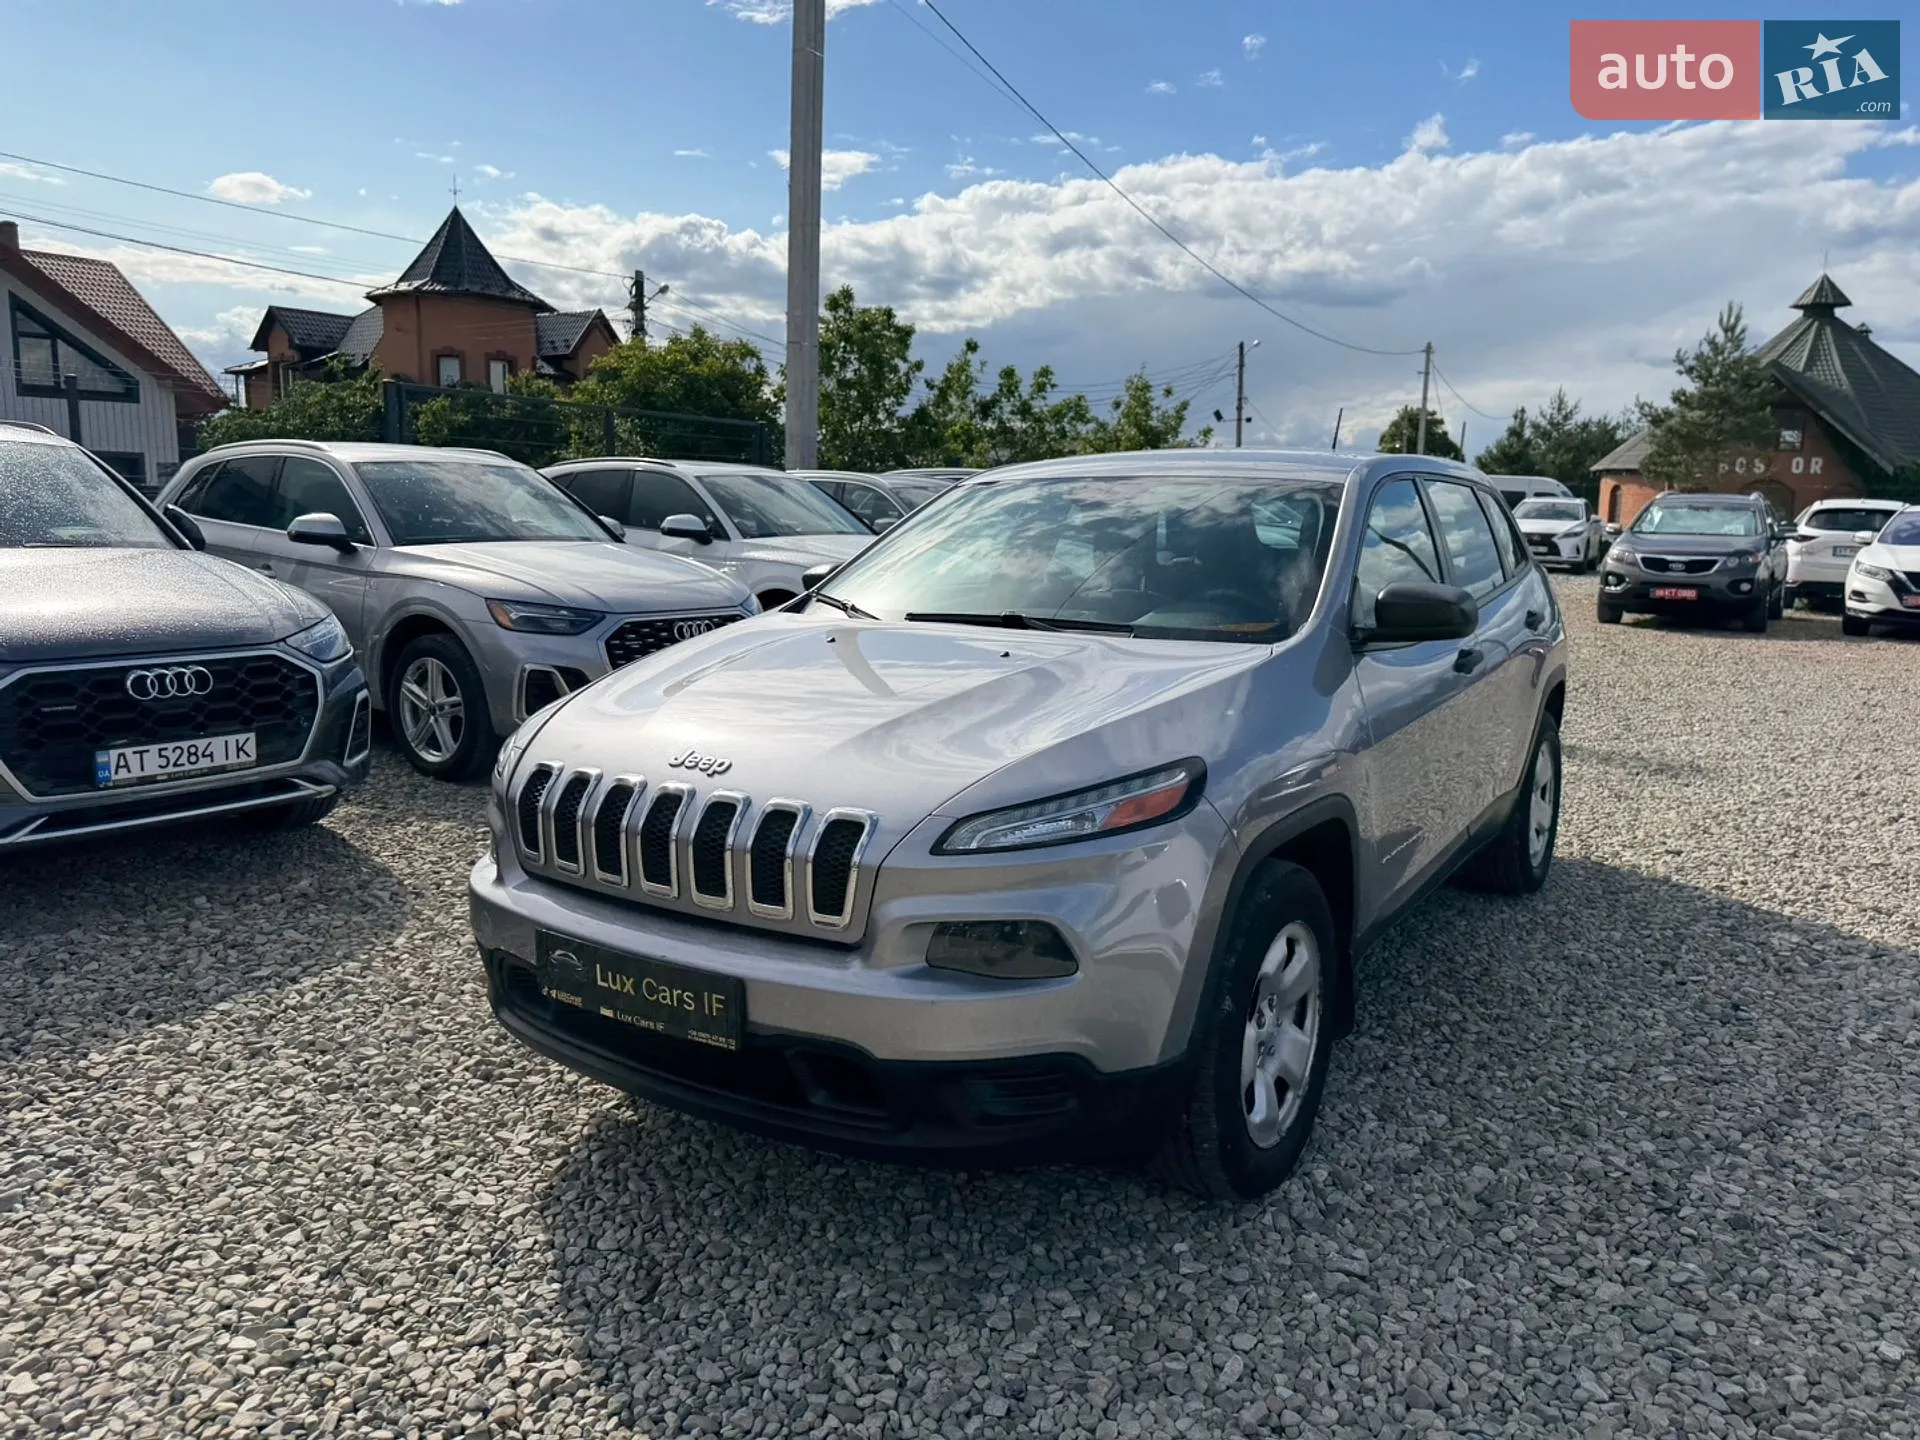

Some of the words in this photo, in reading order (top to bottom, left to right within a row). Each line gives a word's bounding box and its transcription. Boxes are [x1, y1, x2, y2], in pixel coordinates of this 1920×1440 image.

[114, 750, 150, 776] AT
[157, 741, 215, 770] 5284
[224, 737, 252, 761] IK
[668, 749, 733, 778] Jeep
[596, 963, 636, 996] Lux
[642, 977, 695, 1011] Cars
[704, 991, 726, 1017] IF
